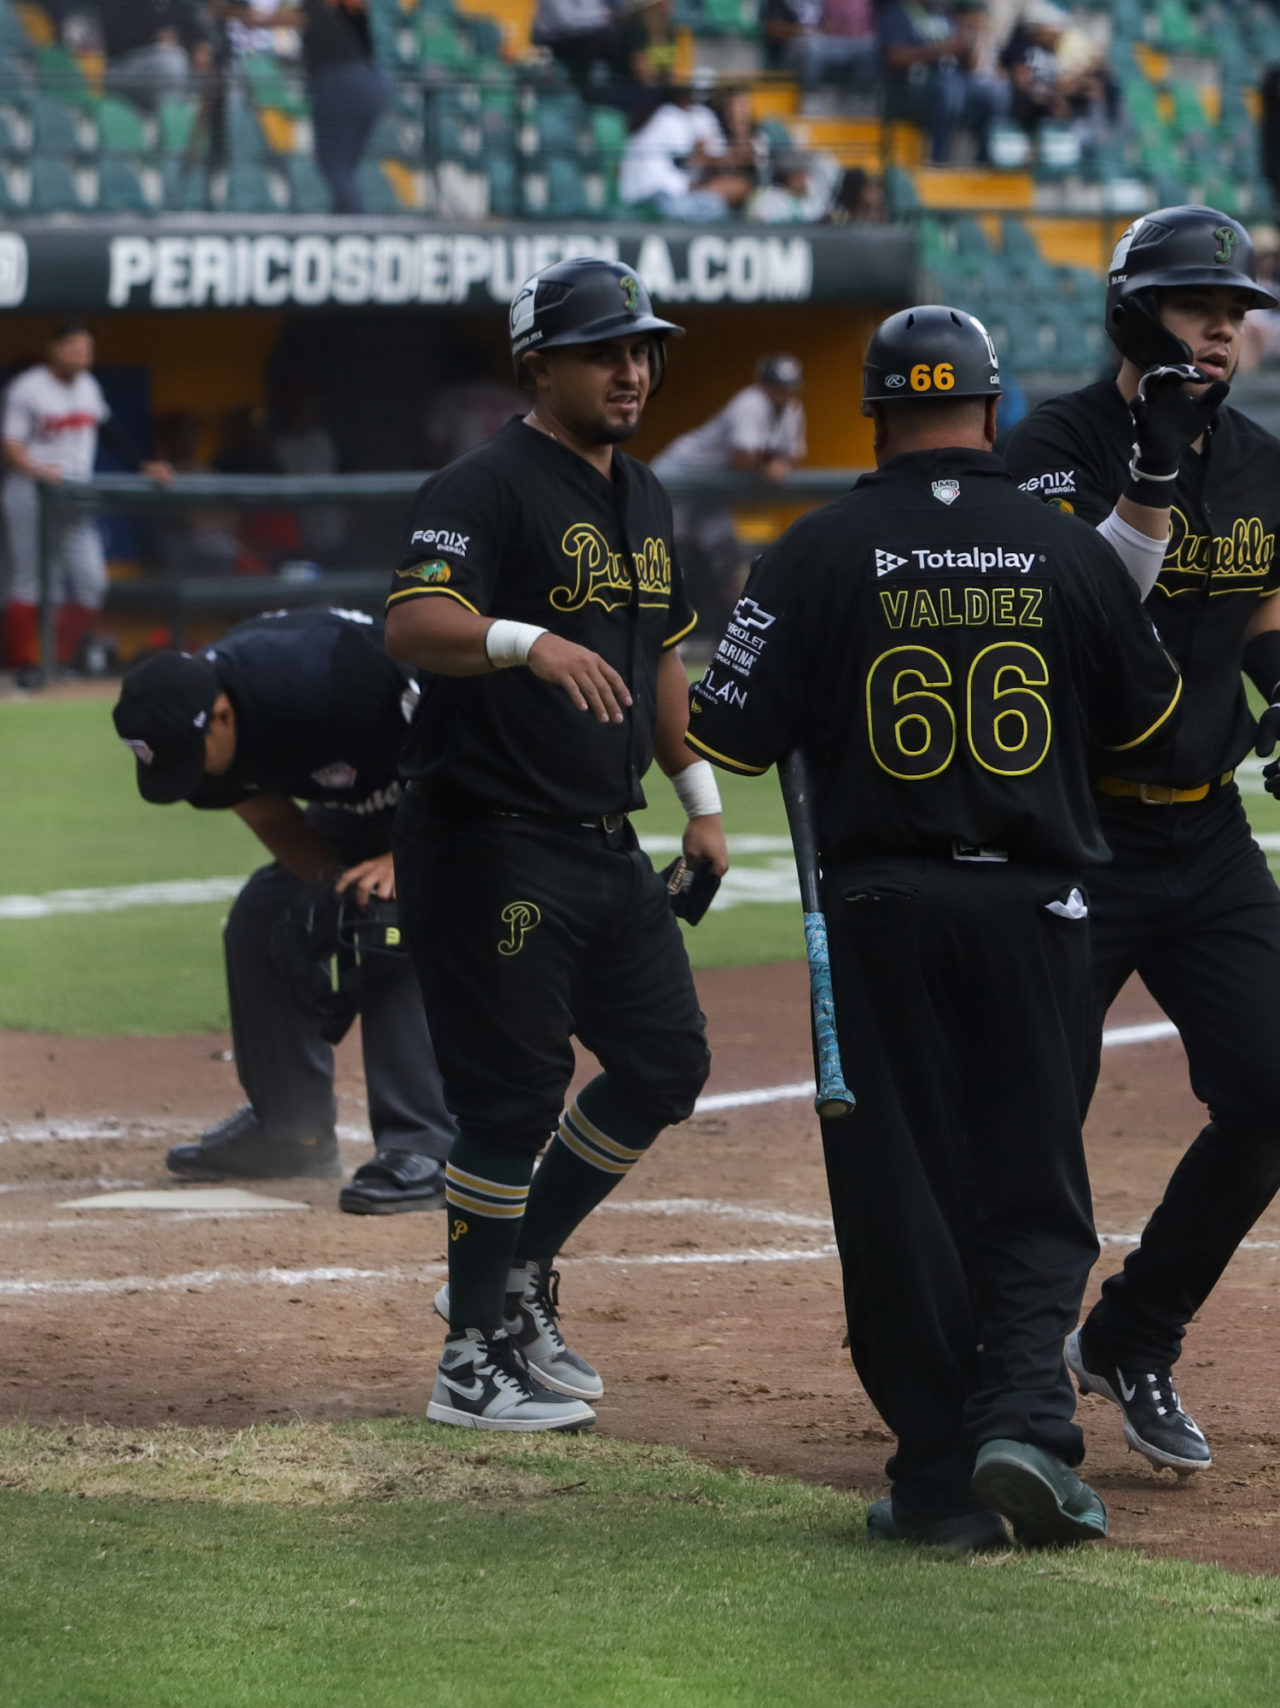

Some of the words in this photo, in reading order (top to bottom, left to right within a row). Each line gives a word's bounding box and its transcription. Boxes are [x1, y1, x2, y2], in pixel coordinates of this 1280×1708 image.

[910, 362, 955, 391] 66
[911, 546, 1036, 574] Totalplay
[879, 587, 1044, 630] VALDEZ
[866, 640, 1052, 781] 66
